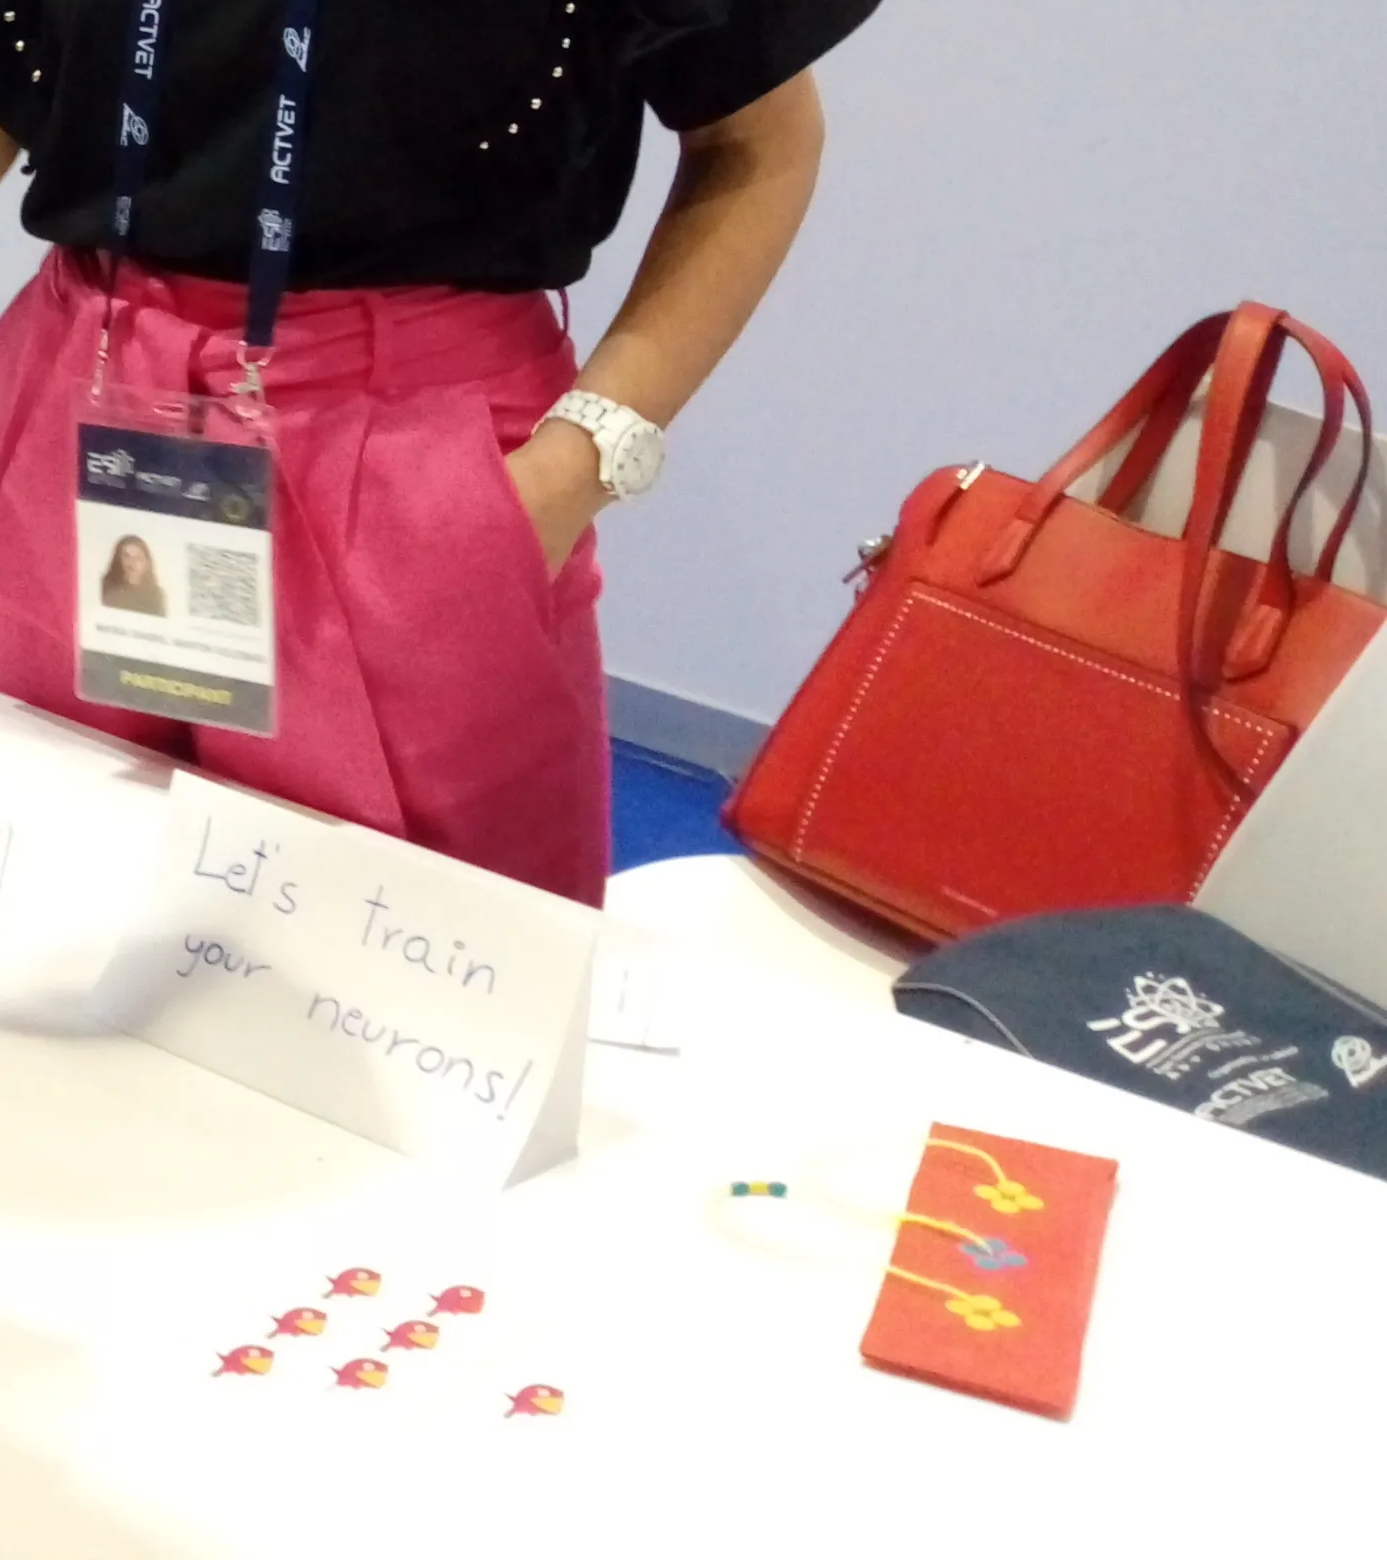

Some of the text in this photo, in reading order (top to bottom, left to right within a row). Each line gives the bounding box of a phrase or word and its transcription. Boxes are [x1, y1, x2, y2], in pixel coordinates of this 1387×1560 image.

[270, 94, 297, 185] ACTVET
[193, 816, 496, 995] Let's train
[176, 933, 534, 1122] your neurons!
